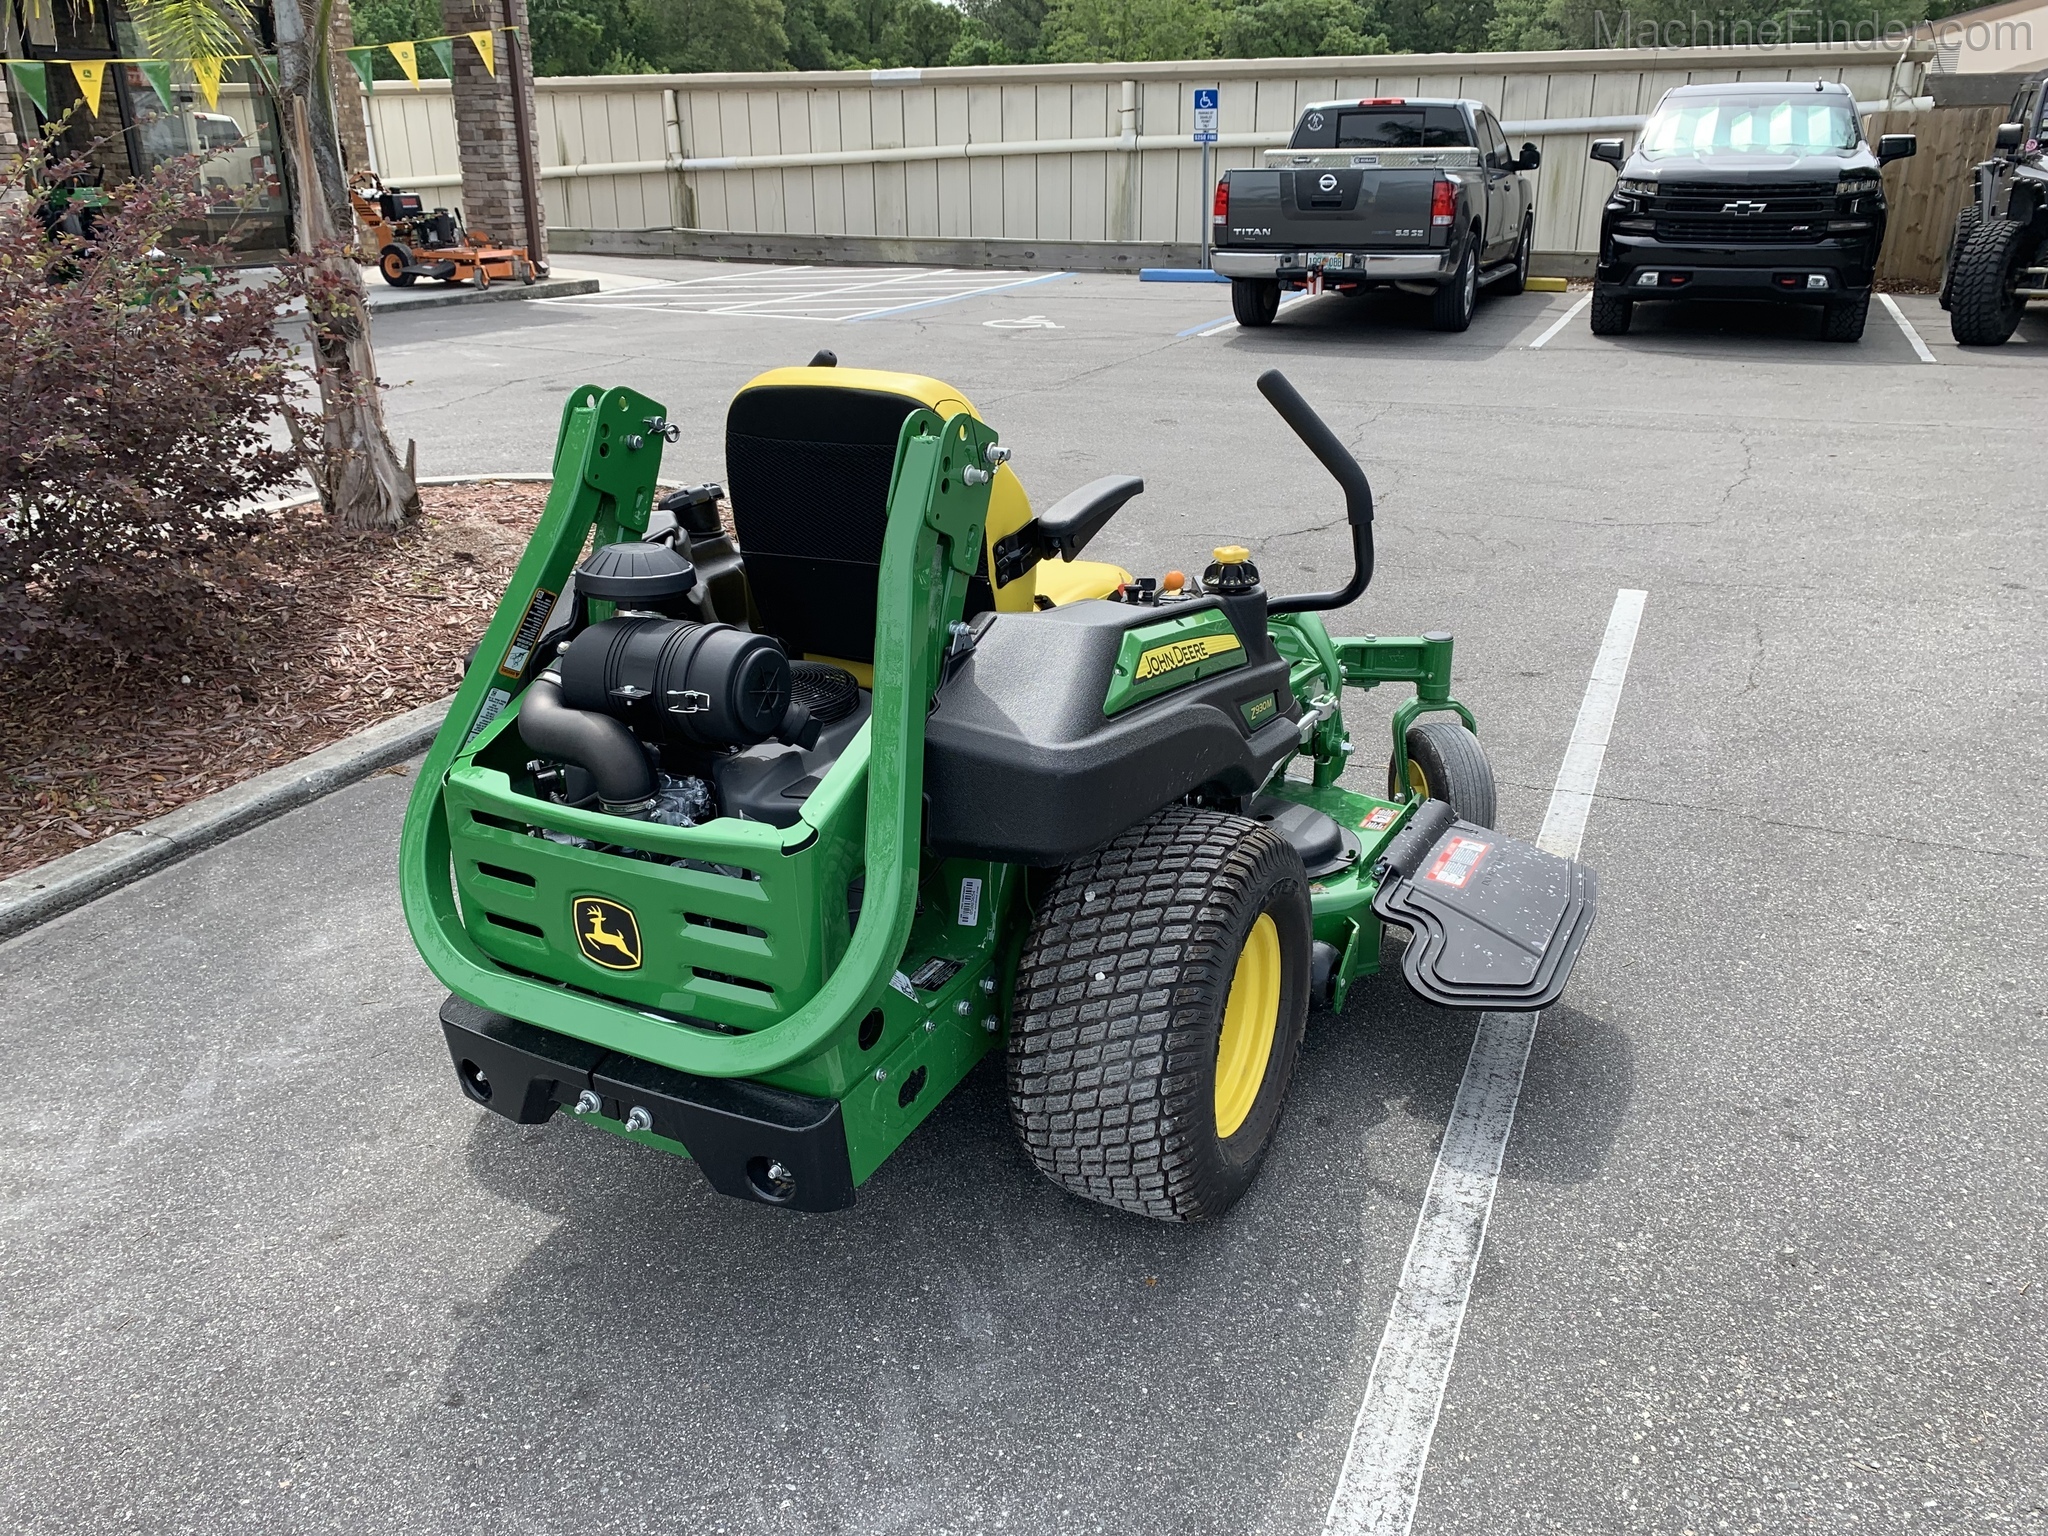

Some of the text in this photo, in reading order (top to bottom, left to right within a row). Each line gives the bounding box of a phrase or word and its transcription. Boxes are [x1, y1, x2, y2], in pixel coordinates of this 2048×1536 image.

[1233, 228, 1271, 236] TITAN
[1145, 642, 1209, 675] JOHN DEERE
[1250, 698, 1273, 720] Z930M
